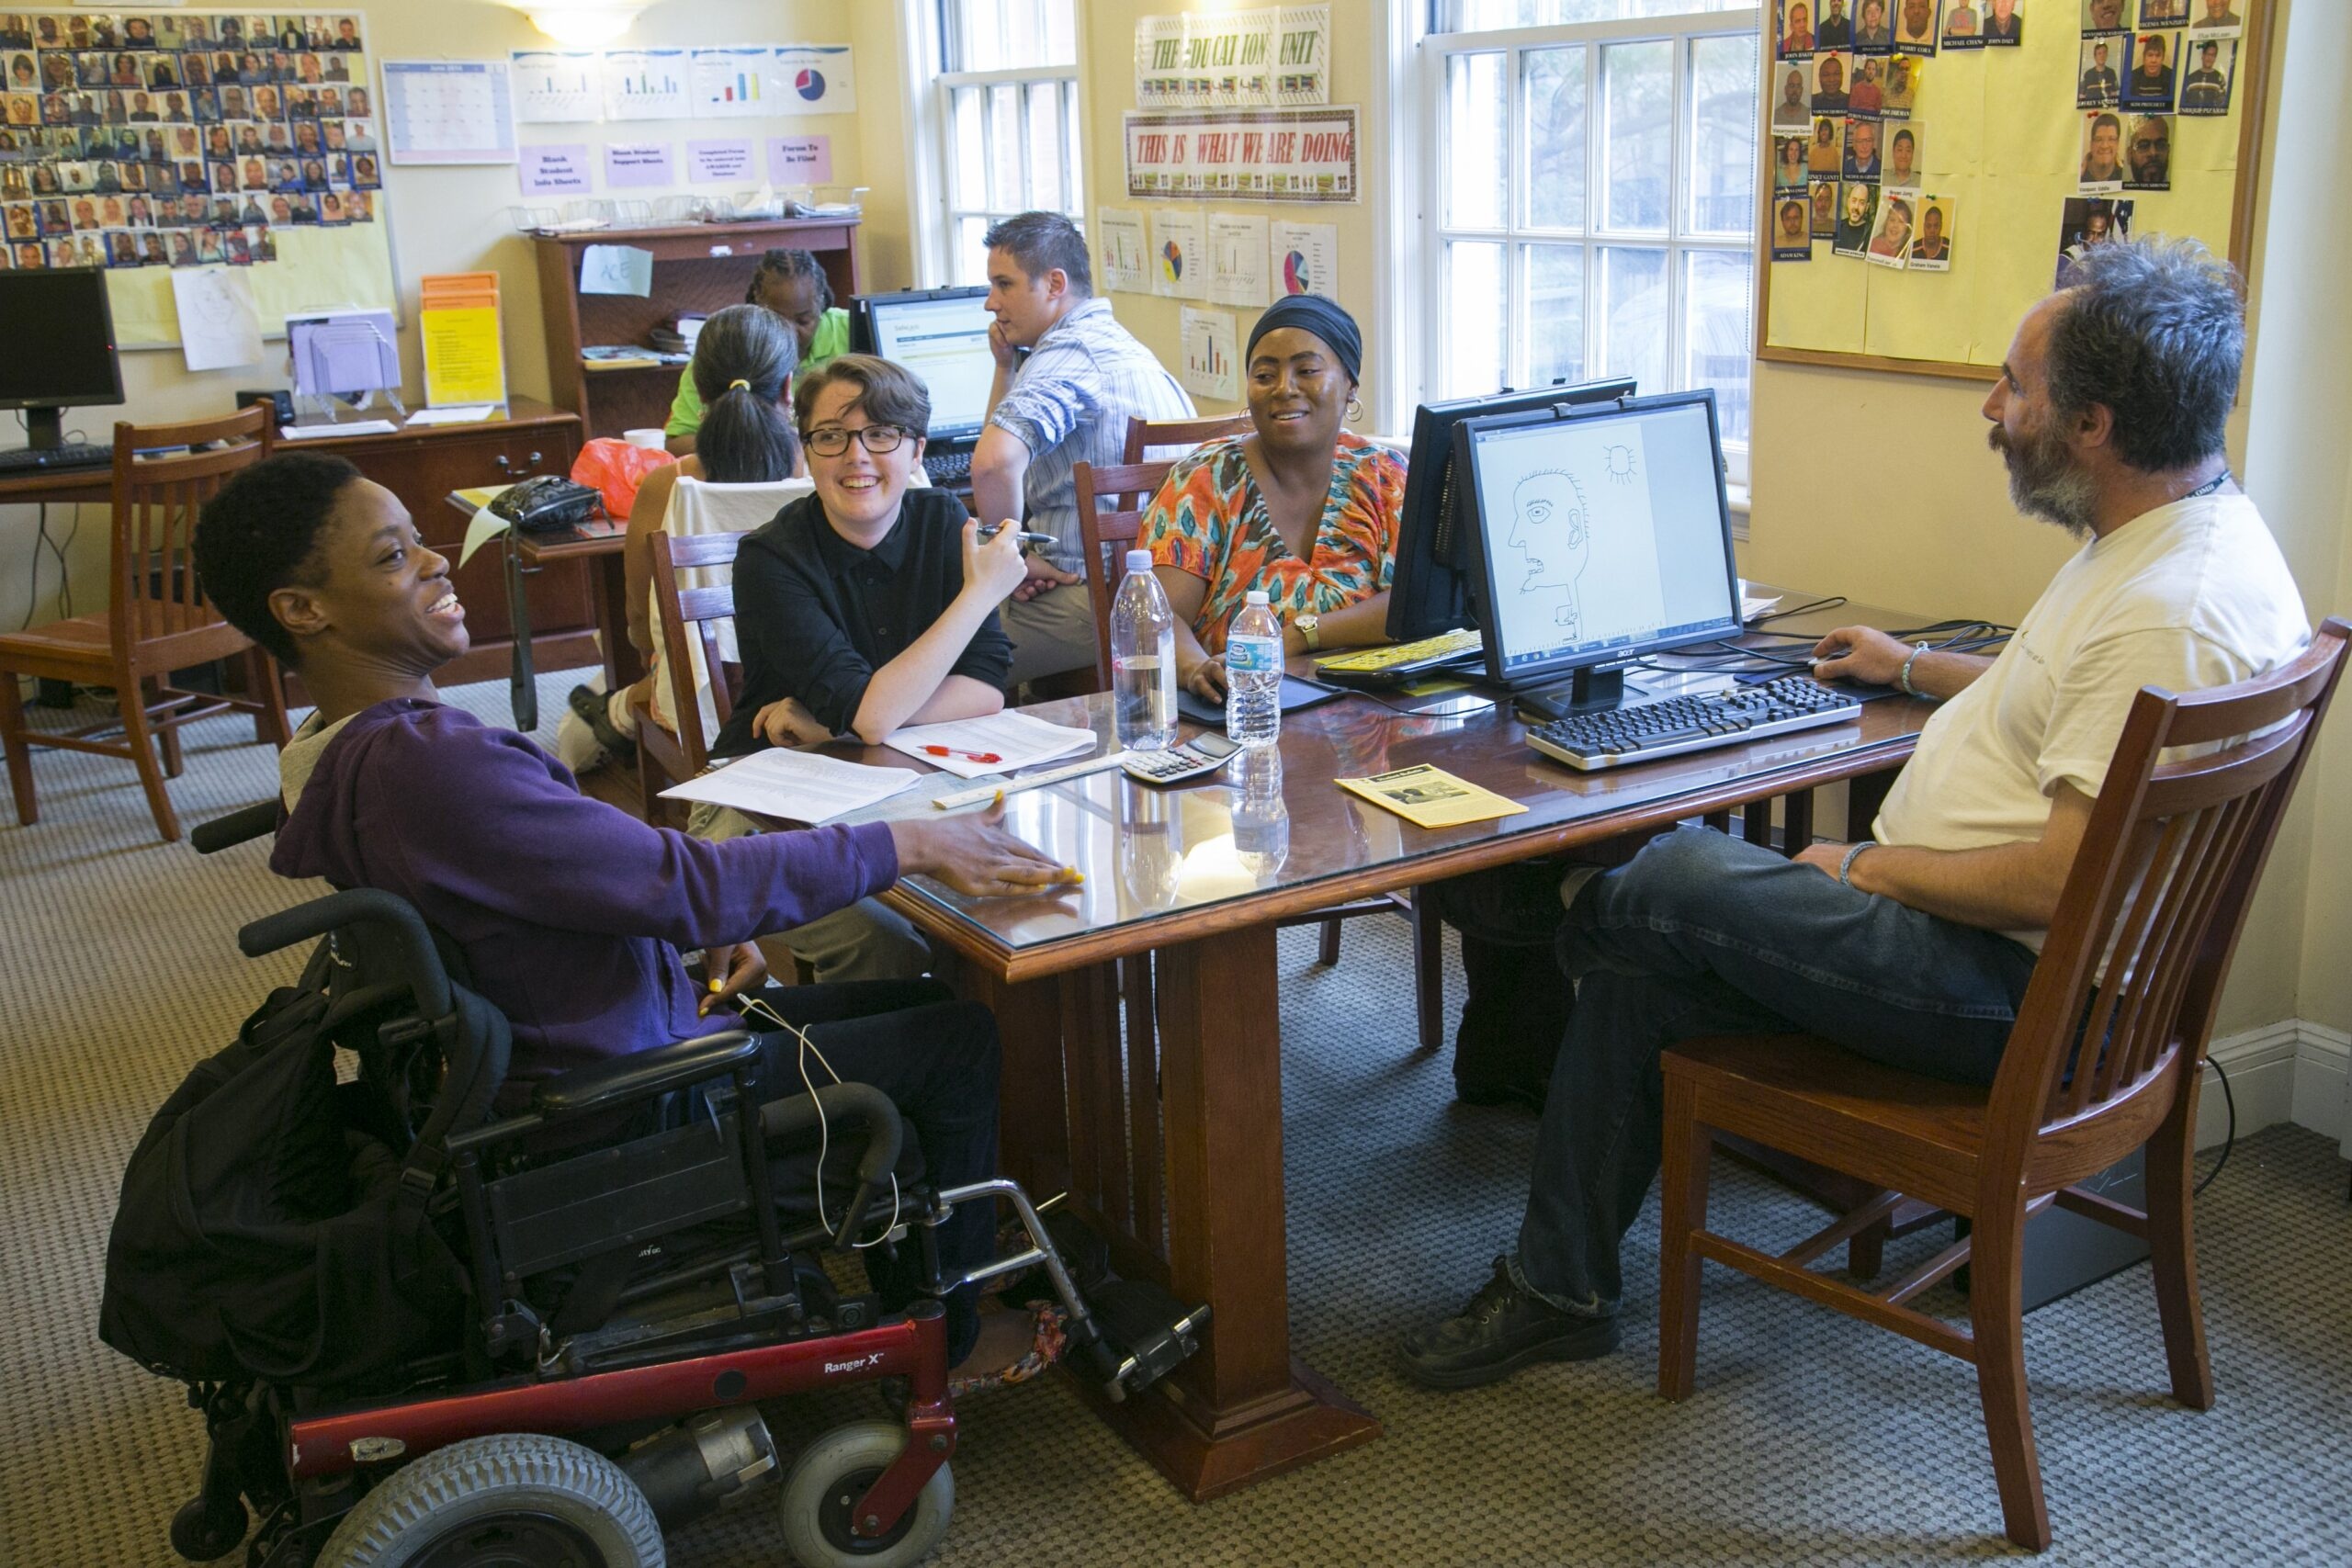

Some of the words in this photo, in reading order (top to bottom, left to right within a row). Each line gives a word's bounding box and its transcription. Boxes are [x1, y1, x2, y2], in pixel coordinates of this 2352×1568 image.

[1152, 39, 1181, 70] THE
[1279, 30, 1318, 65] UNIT
[1136, 134, 1168, 164] THIS
[1171, 134, 1187, 164] IS
[1197, 132, 1239, 164] WHAT
[1242, 132, 1264, 164] WE
[1266, 131, 1296, 164] ARE
[1301, 131, 1353, 163] DOING
[1617, 648, 1635, 658] acer
[824, 1359, 866, 1373] Ranger
